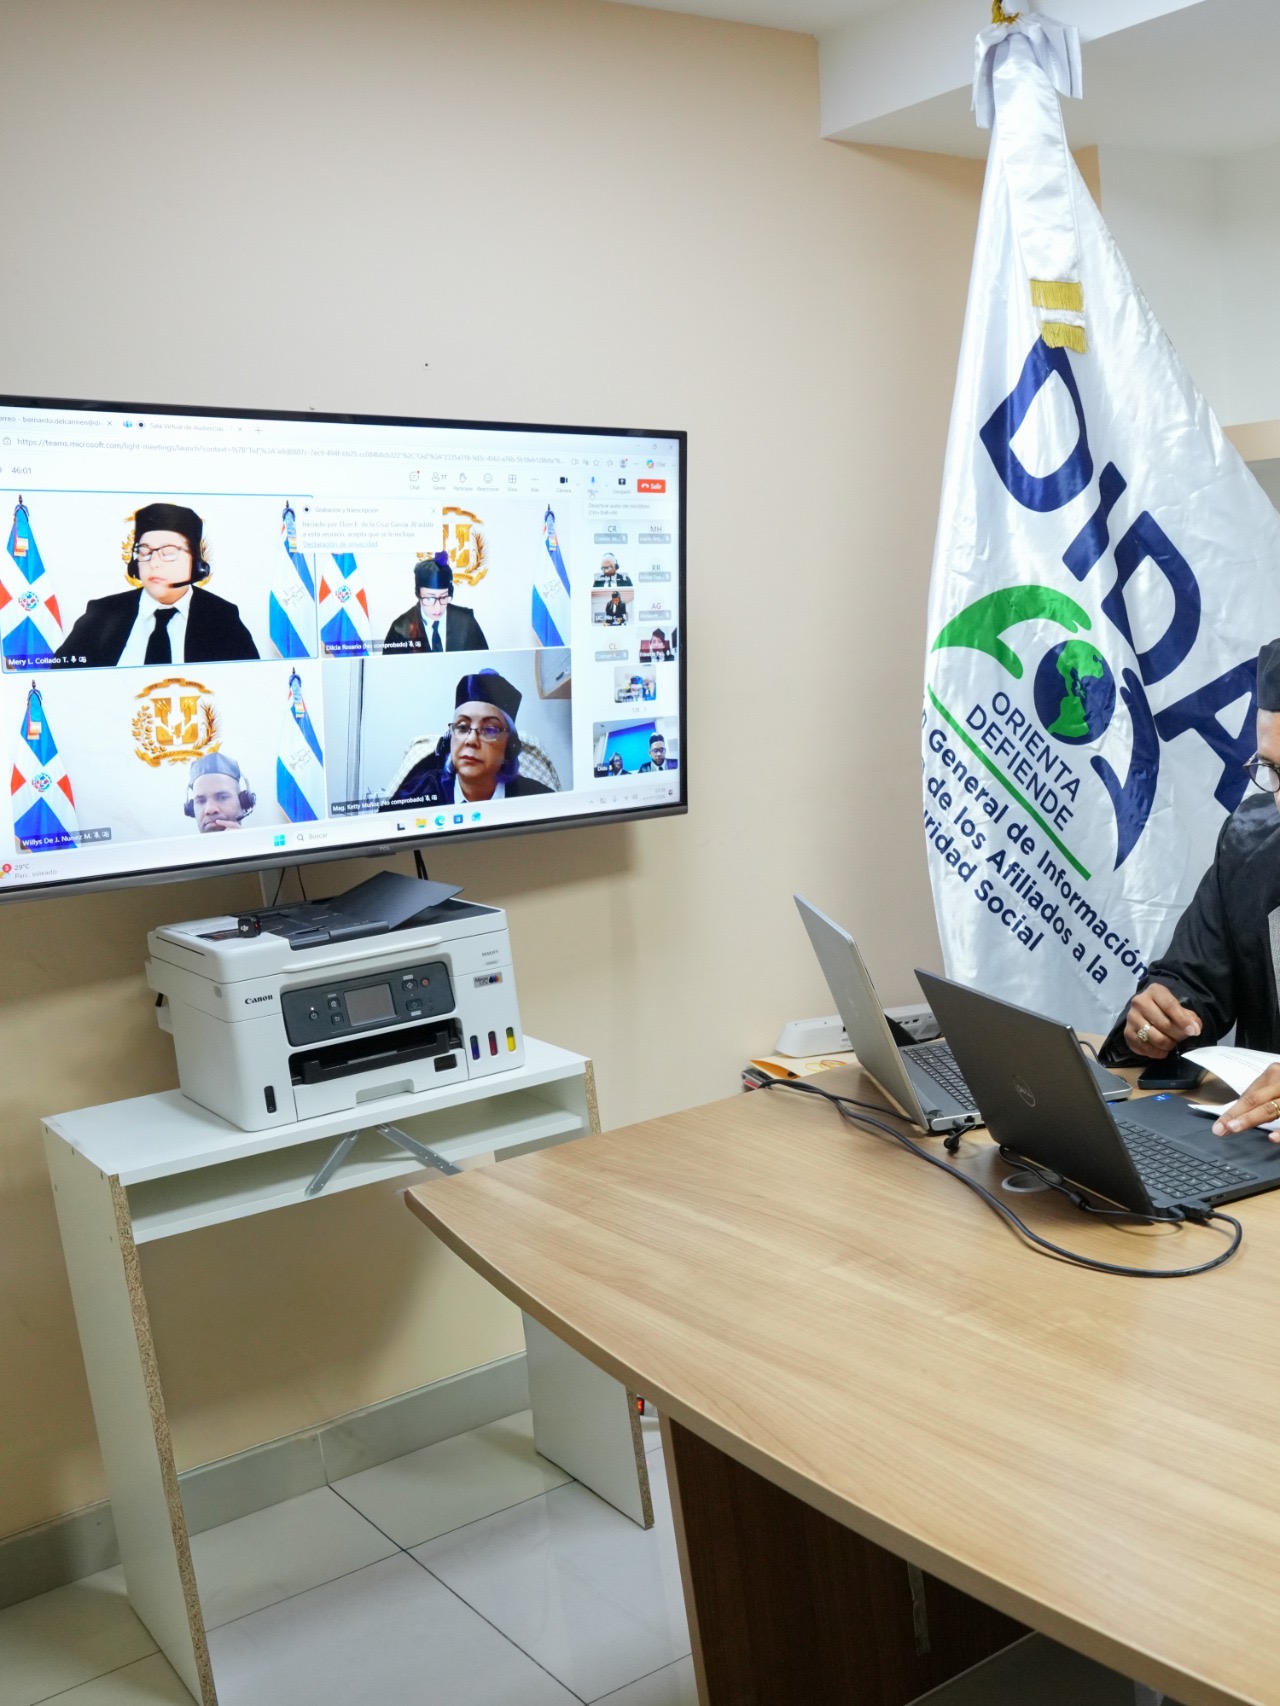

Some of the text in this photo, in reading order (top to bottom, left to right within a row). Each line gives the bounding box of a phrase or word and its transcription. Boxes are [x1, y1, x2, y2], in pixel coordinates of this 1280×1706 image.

[11, 466, 32, 474] 46:01
[607, 525, 617, 533] CR
[979, 334, 1259, 815] DIDA
[8, 658, 26, 666] Mery
[35, 657, 61, 665] Collado
[991, 691, 1081, 802] ORIENTA
[965, 703, 1074, 832] DEFIENDE
[22, 838, 42, 846] Willys
[929, 729, 1149, 981] General de Información
[14, 863, 30, 871] 29°C
[927, 777, 1108, 984] de los Afiliados a la
[974, 879, 1045, 951] Social
[244, 994, 273, 1005] Canon
